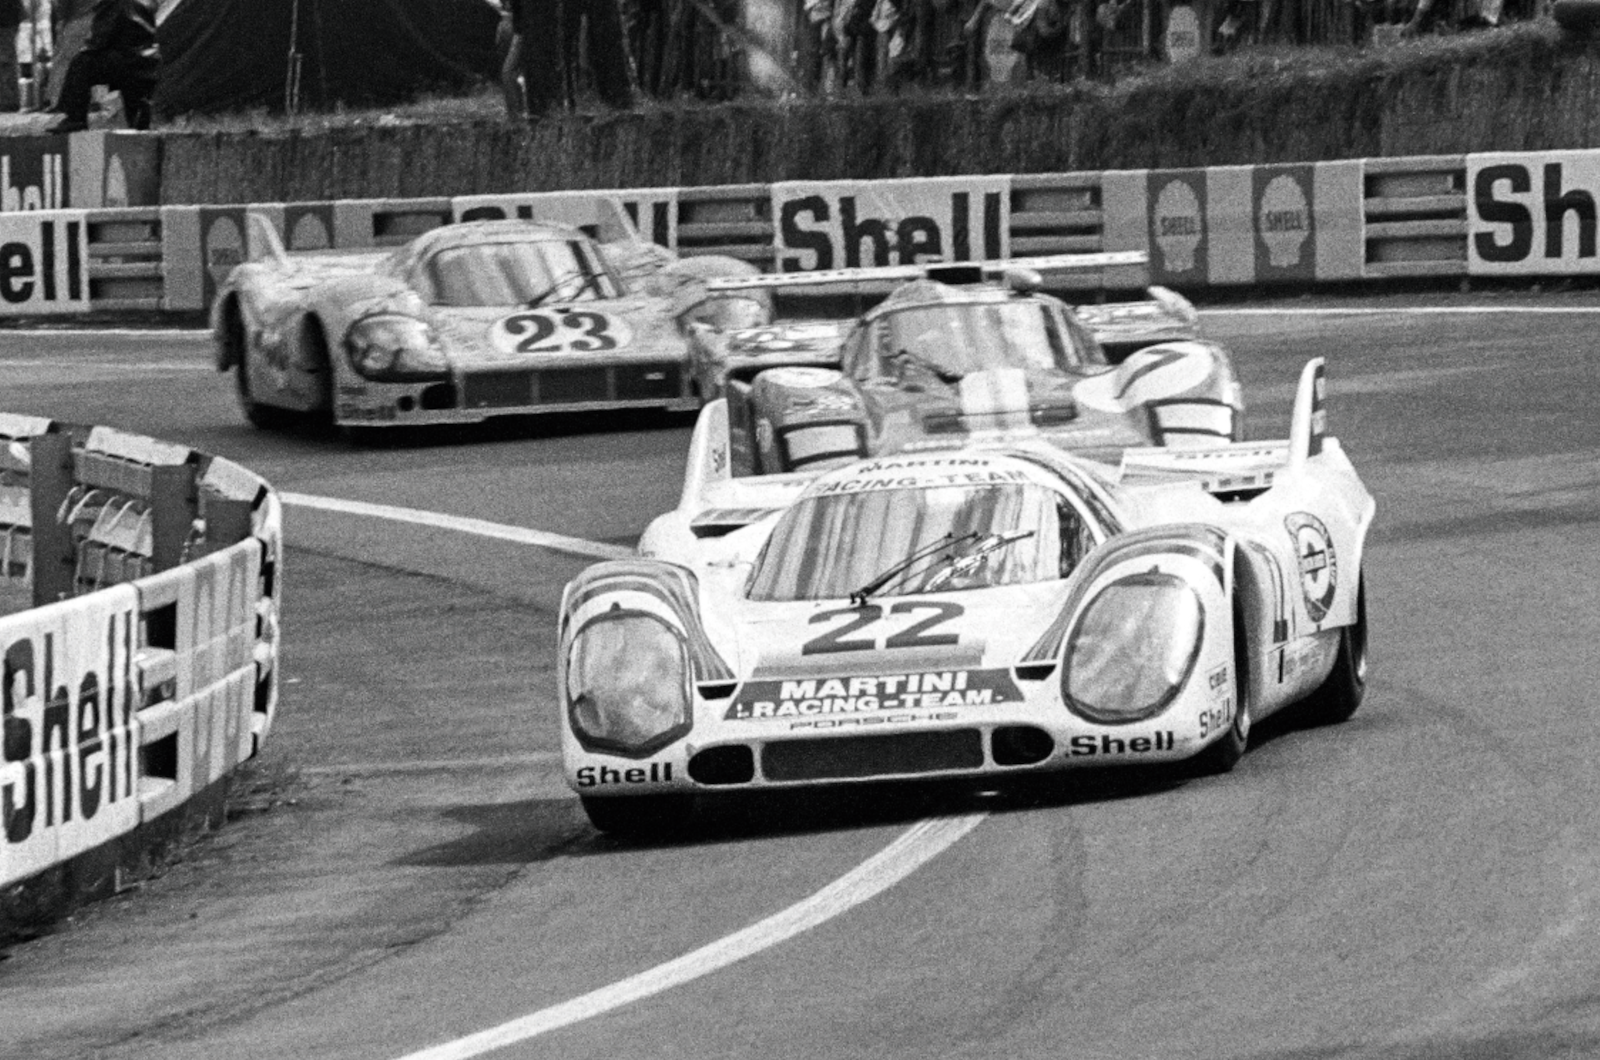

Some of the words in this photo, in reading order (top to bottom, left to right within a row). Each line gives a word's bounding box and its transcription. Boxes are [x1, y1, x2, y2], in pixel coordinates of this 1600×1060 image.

[781, 192, 1001, 271] Shell
[1474, 163, 1597, 263] Sh
[0, 220, 81, 303] ell
[504, 312, 617, 352] 23
[1114, 349, 1189, 400] 7
[858, 458, 989, 475] MARTINI
[802, 602, 965, 655] 22
[752, 689, 993, 718] RACING-TEAM
[779, 671, 968, 700] MARTINI
[3, 609, 134, 844] Shell
[789, 712, 958, 730] PORSCHE
[1200, 697, 1231, 740] Shell
[1070, 731, 1174, 756] Shell
[577, 762, 672, 787] Shell
